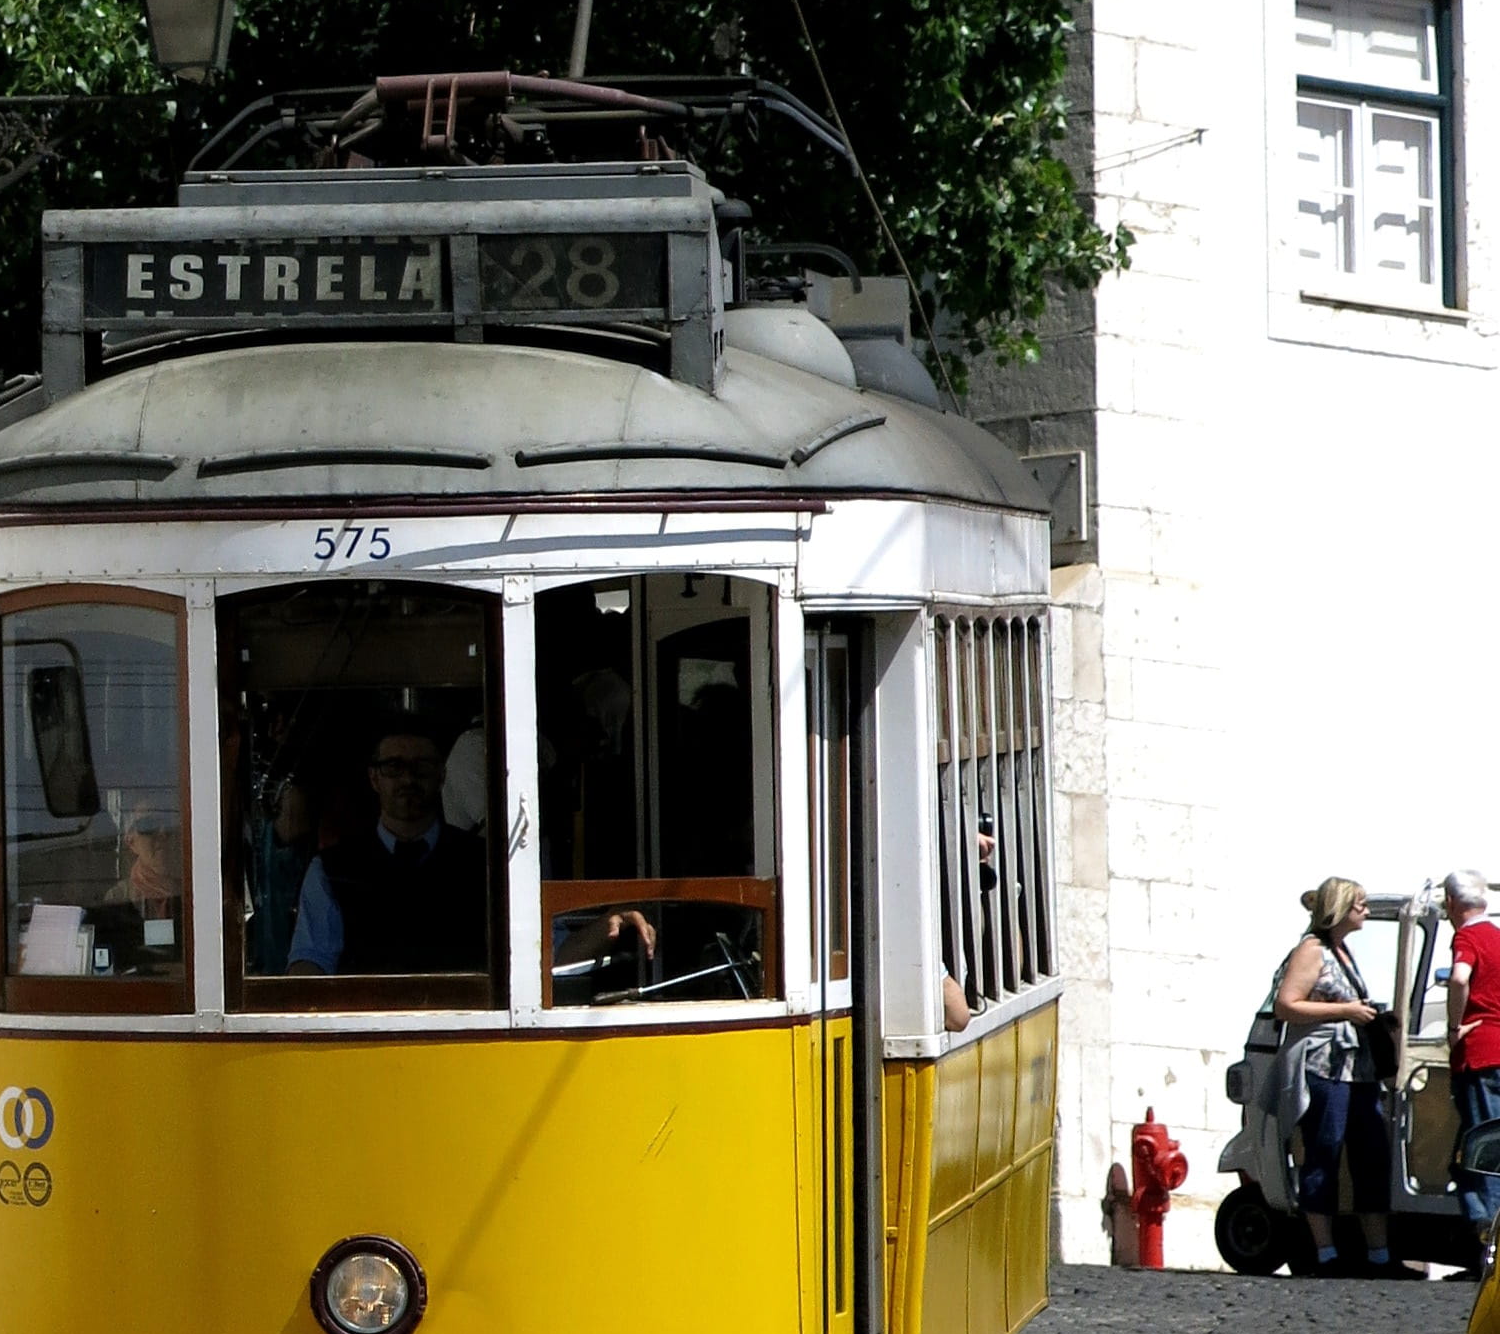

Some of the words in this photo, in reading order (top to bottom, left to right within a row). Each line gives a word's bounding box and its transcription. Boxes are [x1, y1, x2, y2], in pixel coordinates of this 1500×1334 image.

[126, 254, 432, 301] ESTRELA
[510, 237, 620, 308] 28
[314, 527, 391, 560] 575
